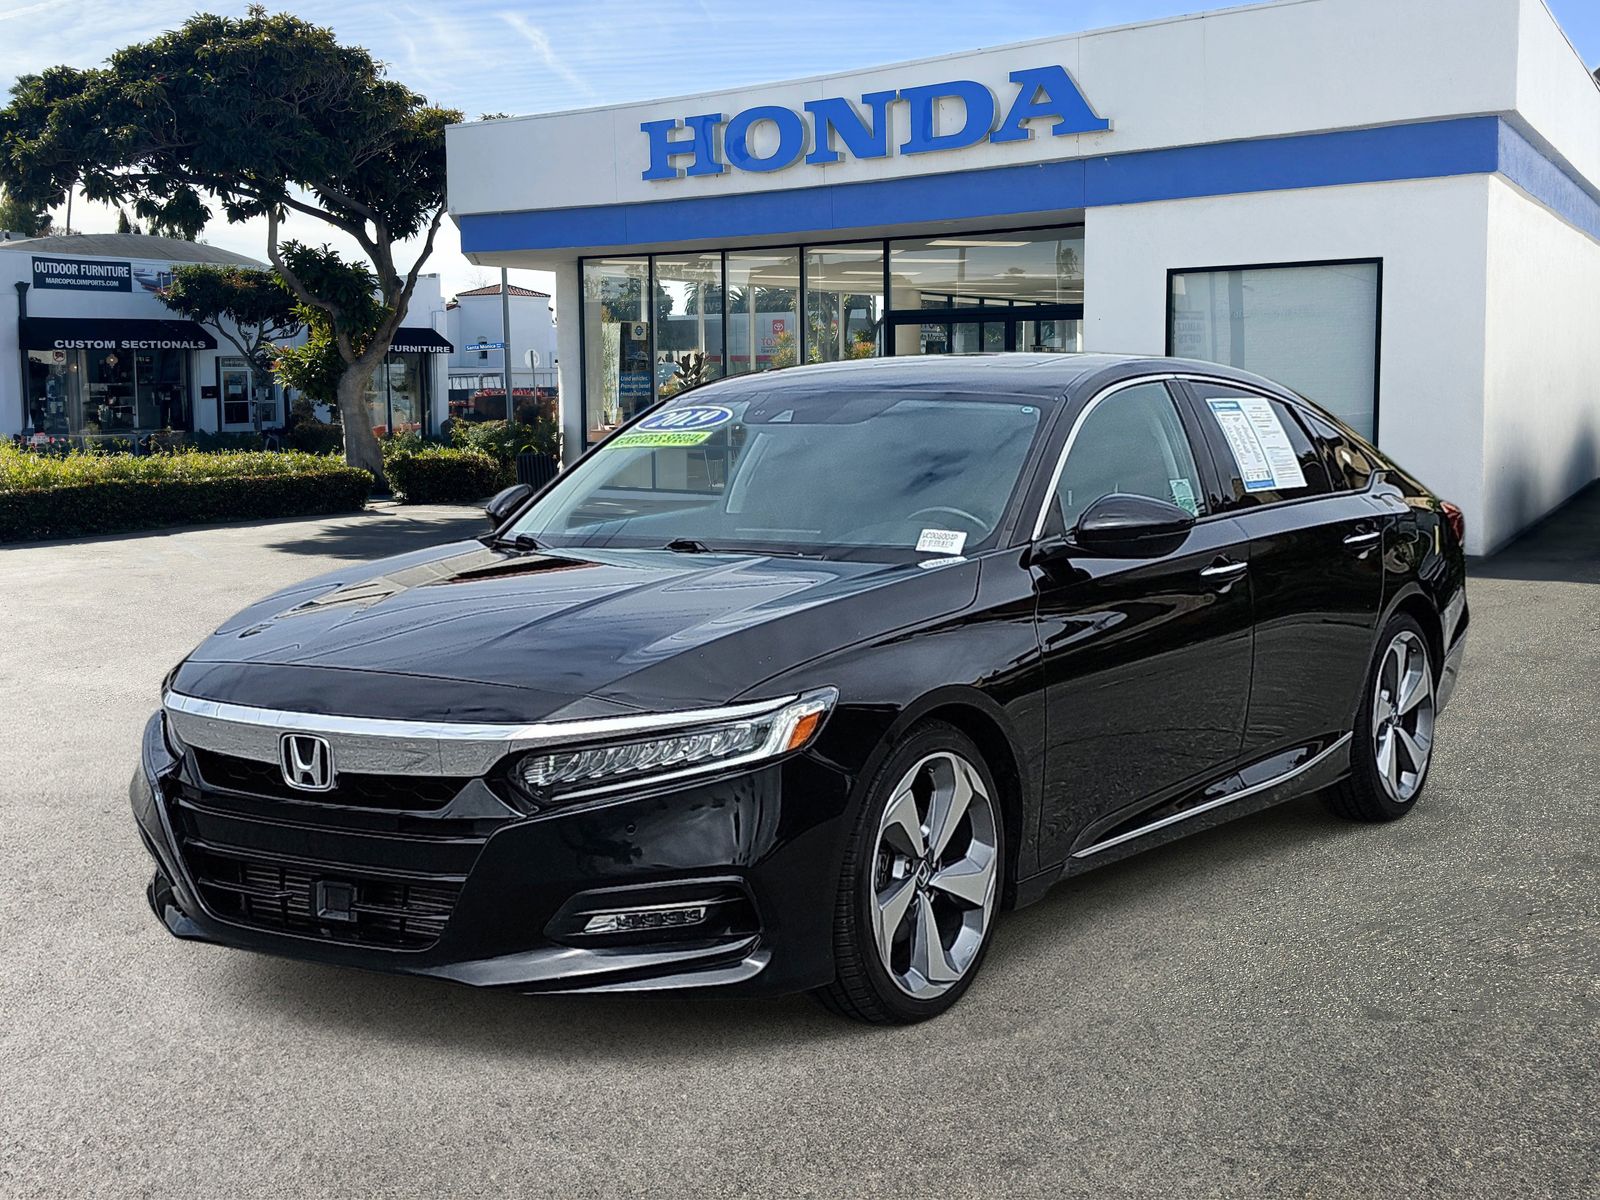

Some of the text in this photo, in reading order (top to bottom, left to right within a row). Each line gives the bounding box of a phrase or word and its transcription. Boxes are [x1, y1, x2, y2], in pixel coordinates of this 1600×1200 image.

[640, 64, 1114, 182] HONDA
[34, 261, 130, 278] OUTDOOR FURNITURE
[45, 277, 119, 287] MARCOPOLOIMPORTS.COM
[54, 339, 206, 349] CUSTOM SECTIONALS
[387, 344, 451, 353] FURNITURE
[645, 409, 722, 428] 2019
